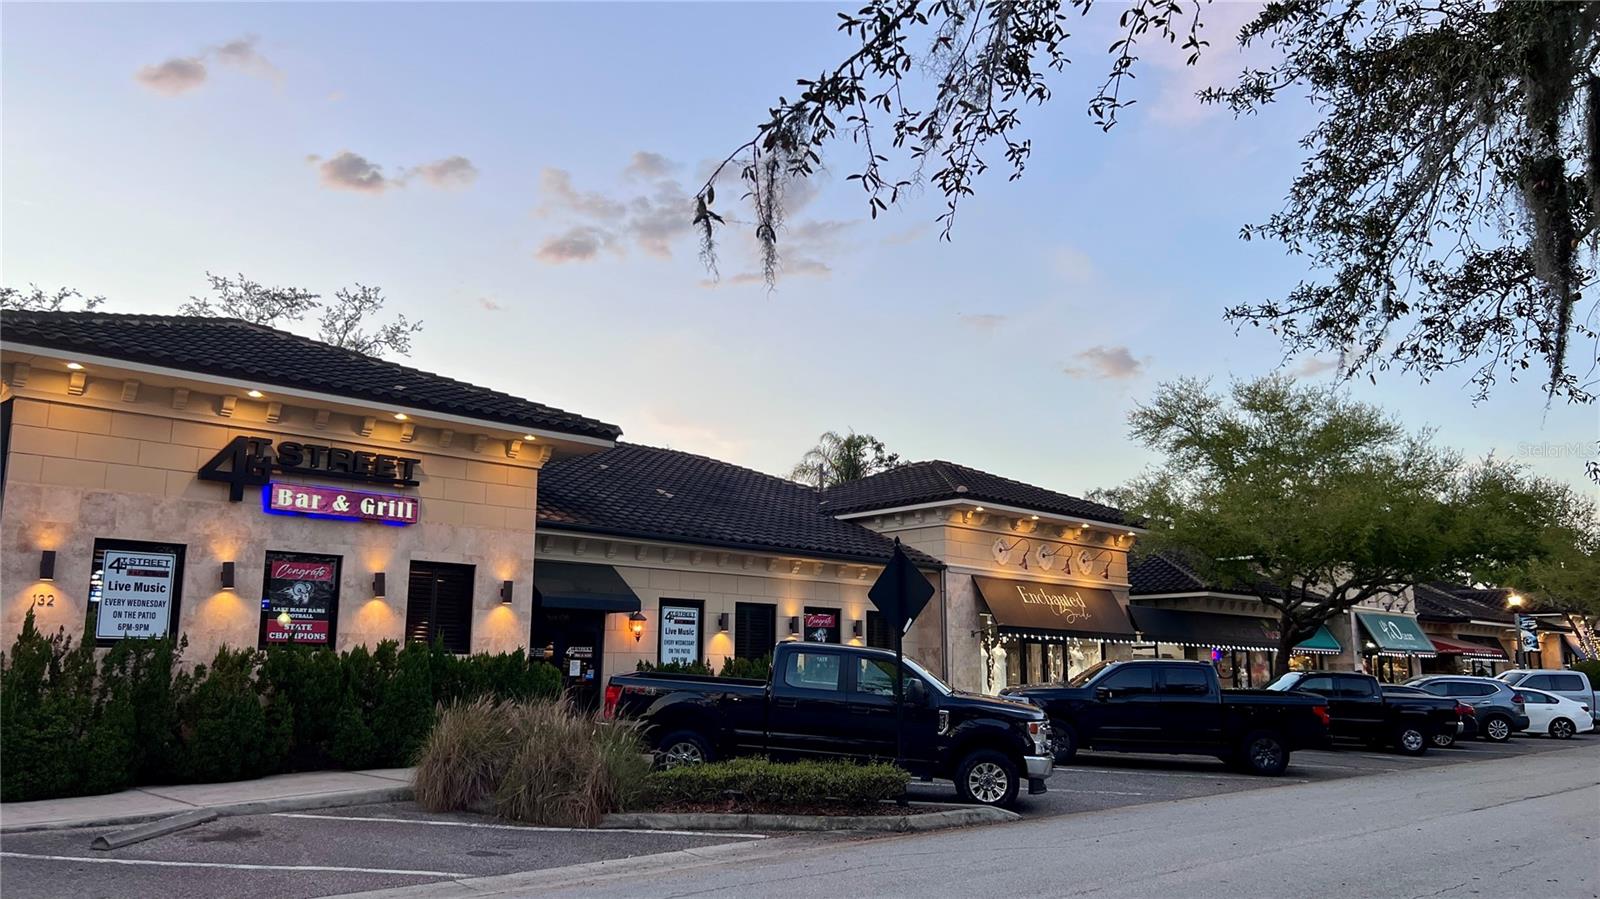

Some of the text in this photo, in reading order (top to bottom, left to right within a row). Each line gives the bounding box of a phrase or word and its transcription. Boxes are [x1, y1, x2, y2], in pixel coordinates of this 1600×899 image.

[276, 441, 421, 480] STREET
[278, 489, 413, 519] Bar & Grill
[128, 558, 171, 568] STREET
[275, 564, 328, 579] Congrats
[108, 581, 166, 593] Live Music
[33, 594, 55, 607] 132
[105, 598, 167, 608] EVERY WEDNESDAY
[1016, 585, 1087, 611] Enchanted
[113, 611, 157, 620] ON THE PATIO
[117, 624, 150, 632] 6PM-9PM
[678, 628, 695, 636] Music
